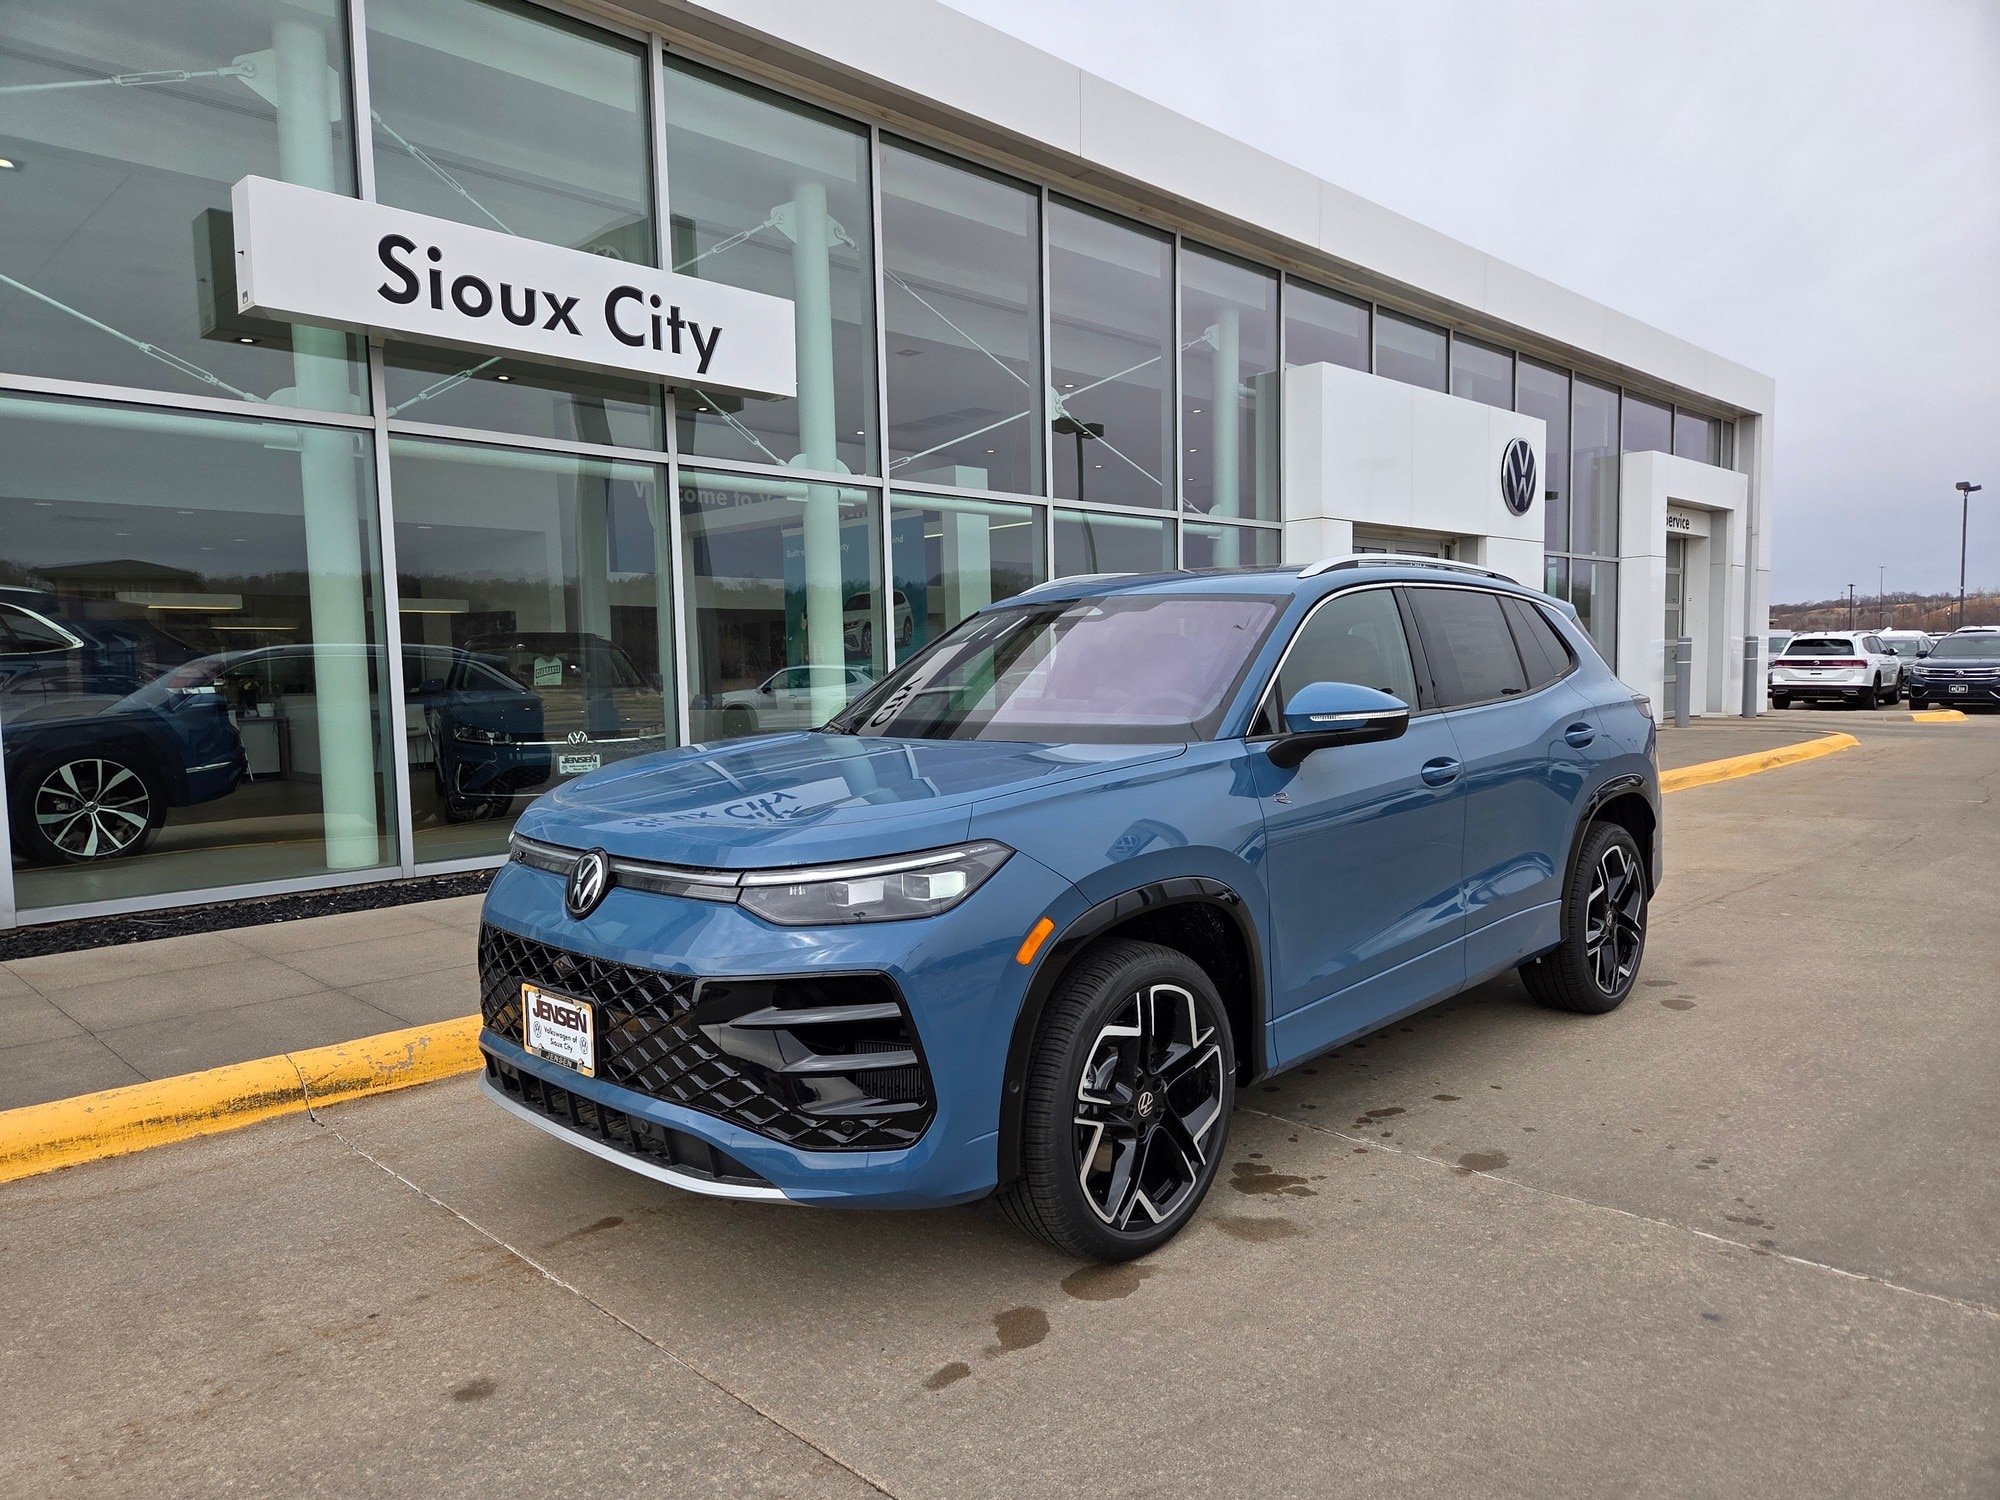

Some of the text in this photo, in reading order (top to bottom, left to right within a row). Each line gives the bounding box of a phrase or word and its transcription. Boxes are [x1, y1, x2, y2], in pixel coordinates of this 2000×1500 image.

[377, 233, 723, 374] Sioux City
[562, 756, 597, 764] JENSEN
[532, 998, 587, 1034] JENSEN
[543, 1025, 578, 1044] Volkswagen of
[550, 1038, 573, 1054] Sioux City
[545, 1051, 573, 1068] JENSEN
